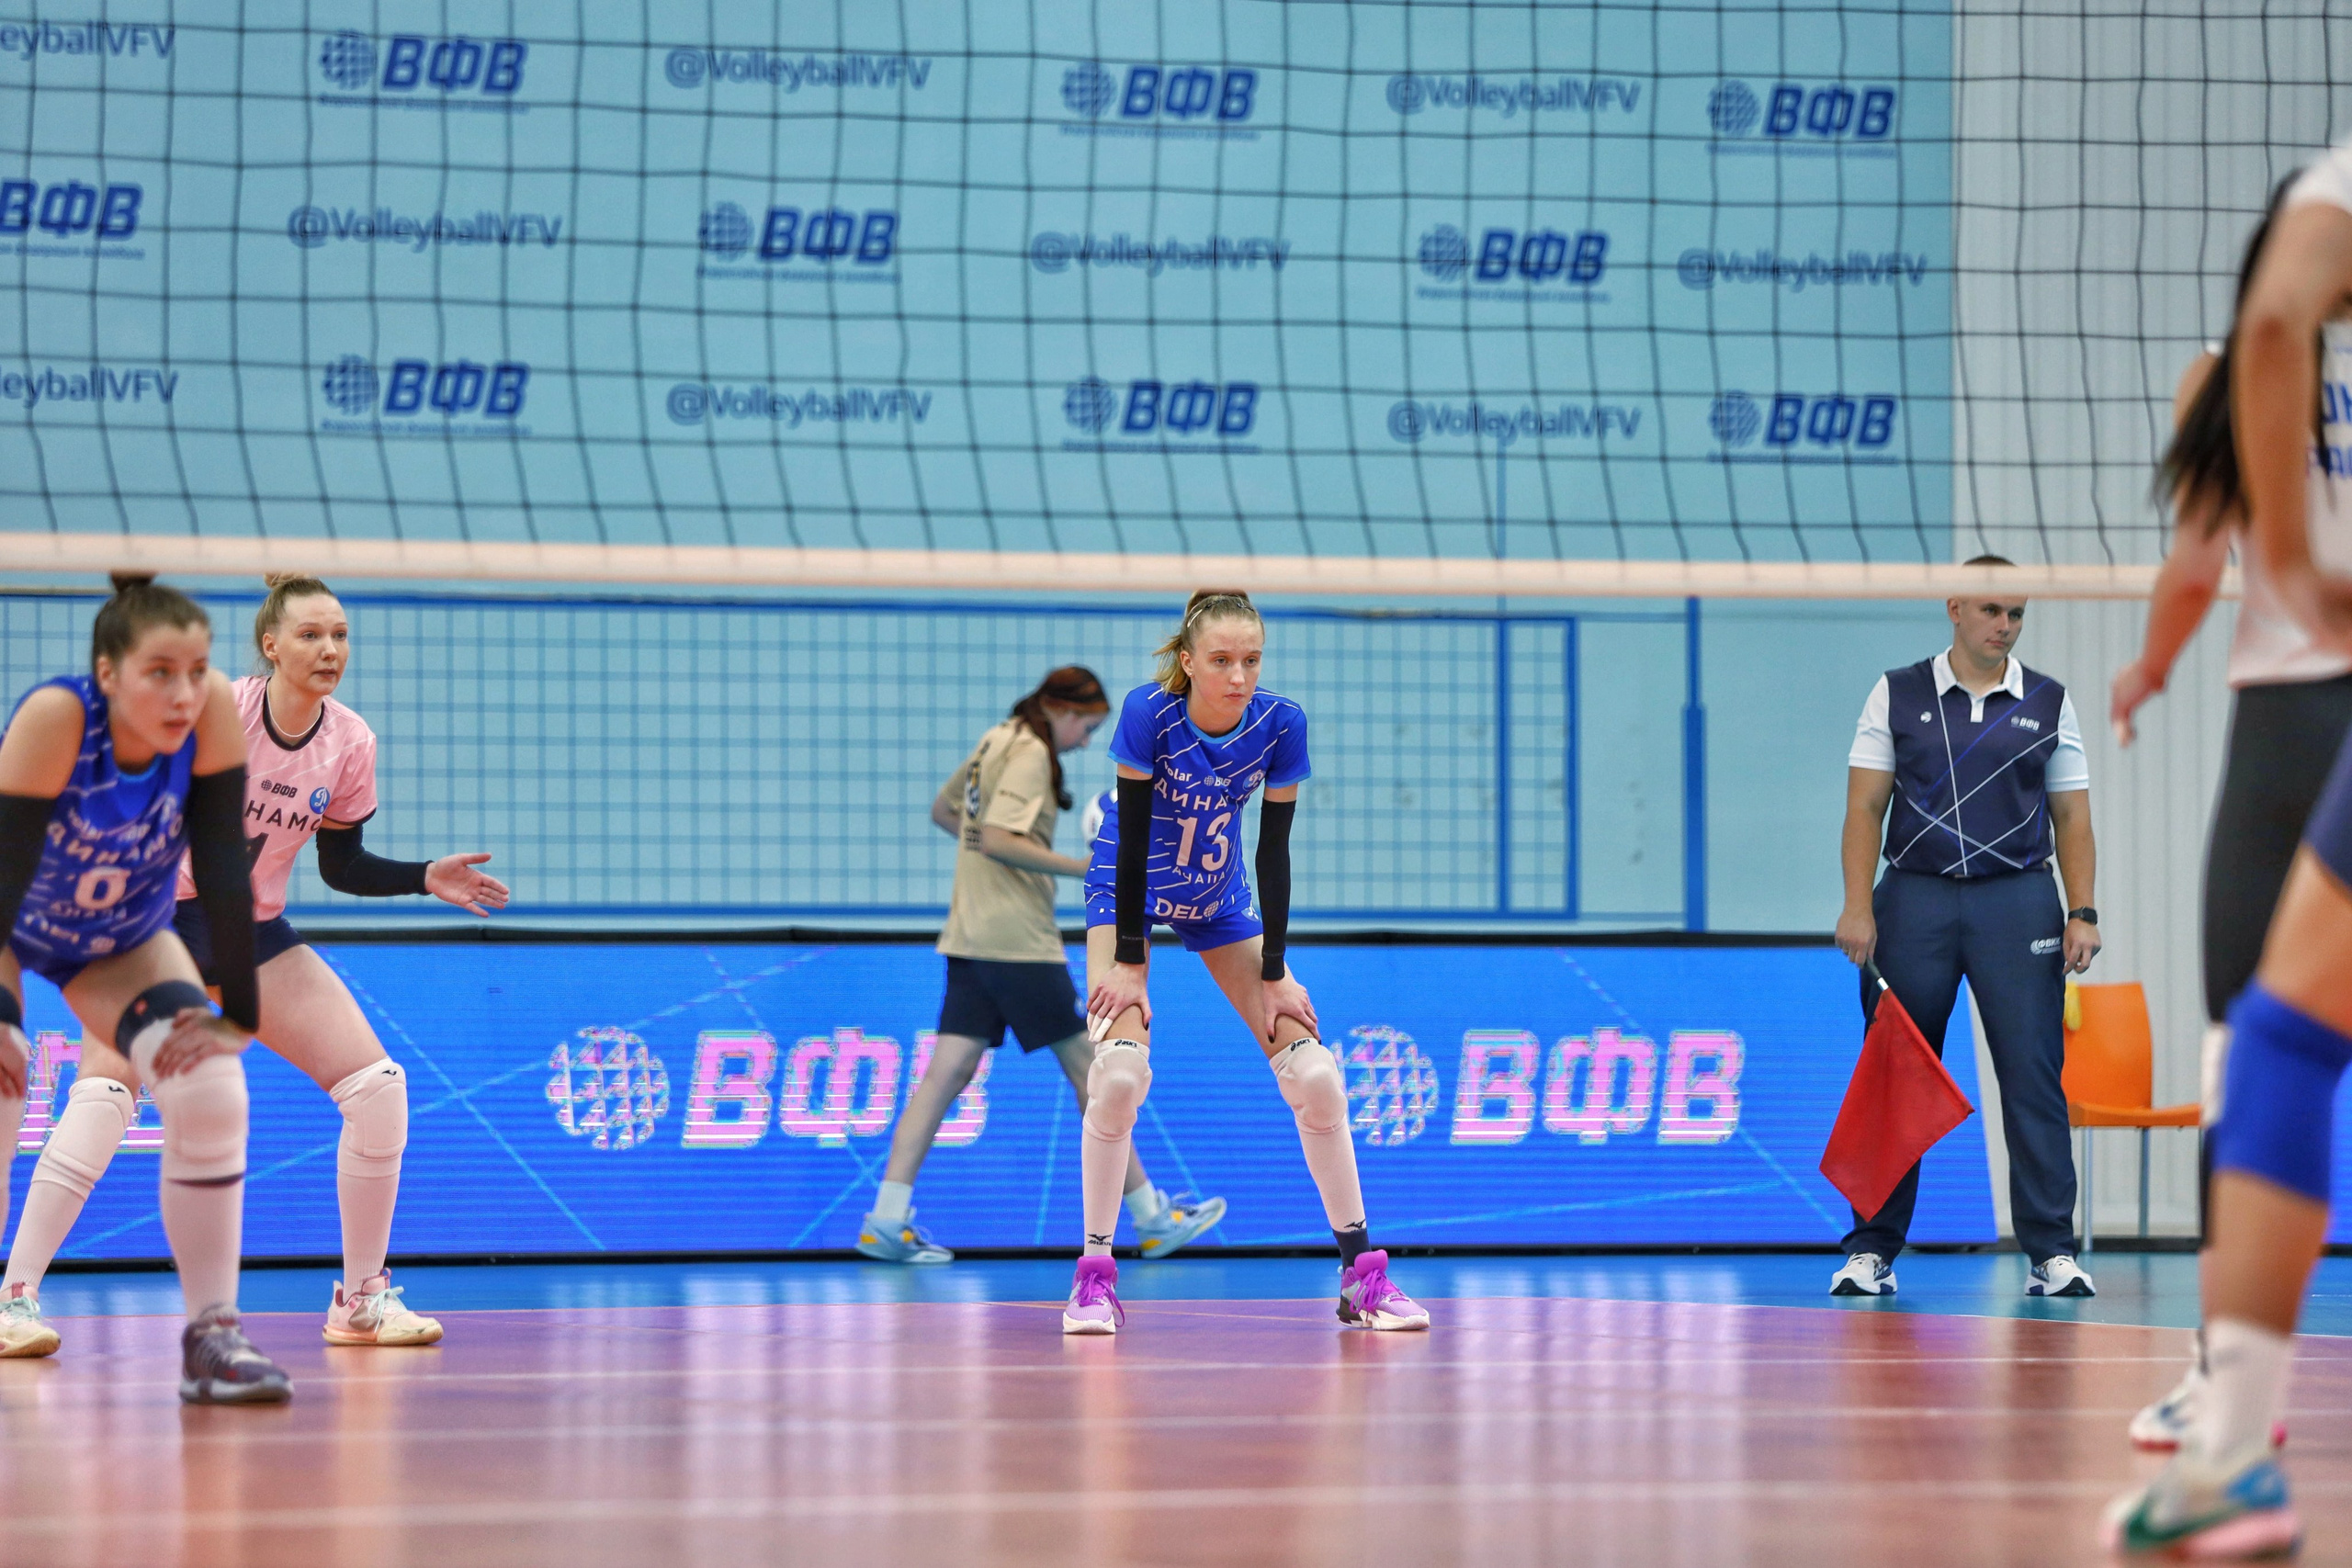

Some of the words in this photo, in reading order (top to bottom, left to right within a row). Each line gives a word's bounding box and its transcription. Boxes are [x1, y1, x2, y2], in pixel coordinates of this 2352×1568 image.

[382, 35, 529, 93] ВФВ
[665, 45, 932, 93] @VolleyballVFV
[1118, 64, 1260, 122] ВФВ
[1385, 73, 1642, 118] @VolleyballVFV
[1764, 85, 1894, 140] ВФВ
[0, 179, 143, 241] ВФВ
[287, 205, 562, 253] @VolleyballVFV
[757, 206, 899, 265] ВФВ
[1031, 231, 1289, 276] @VolleyballVFV
[1475, 229, 1610, 284] ВФВ
[1677, 247, 1928, 293] @VolleyballVFV
[382, 358, 531, 419] ВФВ
[666, 382, 933, 429] @VolleyballVFV
[1119, 379, 1261, 436] ВФВ
[1386, 399, 1643, 444] @VolleyballVFV
[1764, 393, 1896, 448] ВФВ
[271, 783, 298, 798] ВФВ
[1176, 811, 1232, 872] 13
[1451, 1026, 1745, 1146] ВФВ
